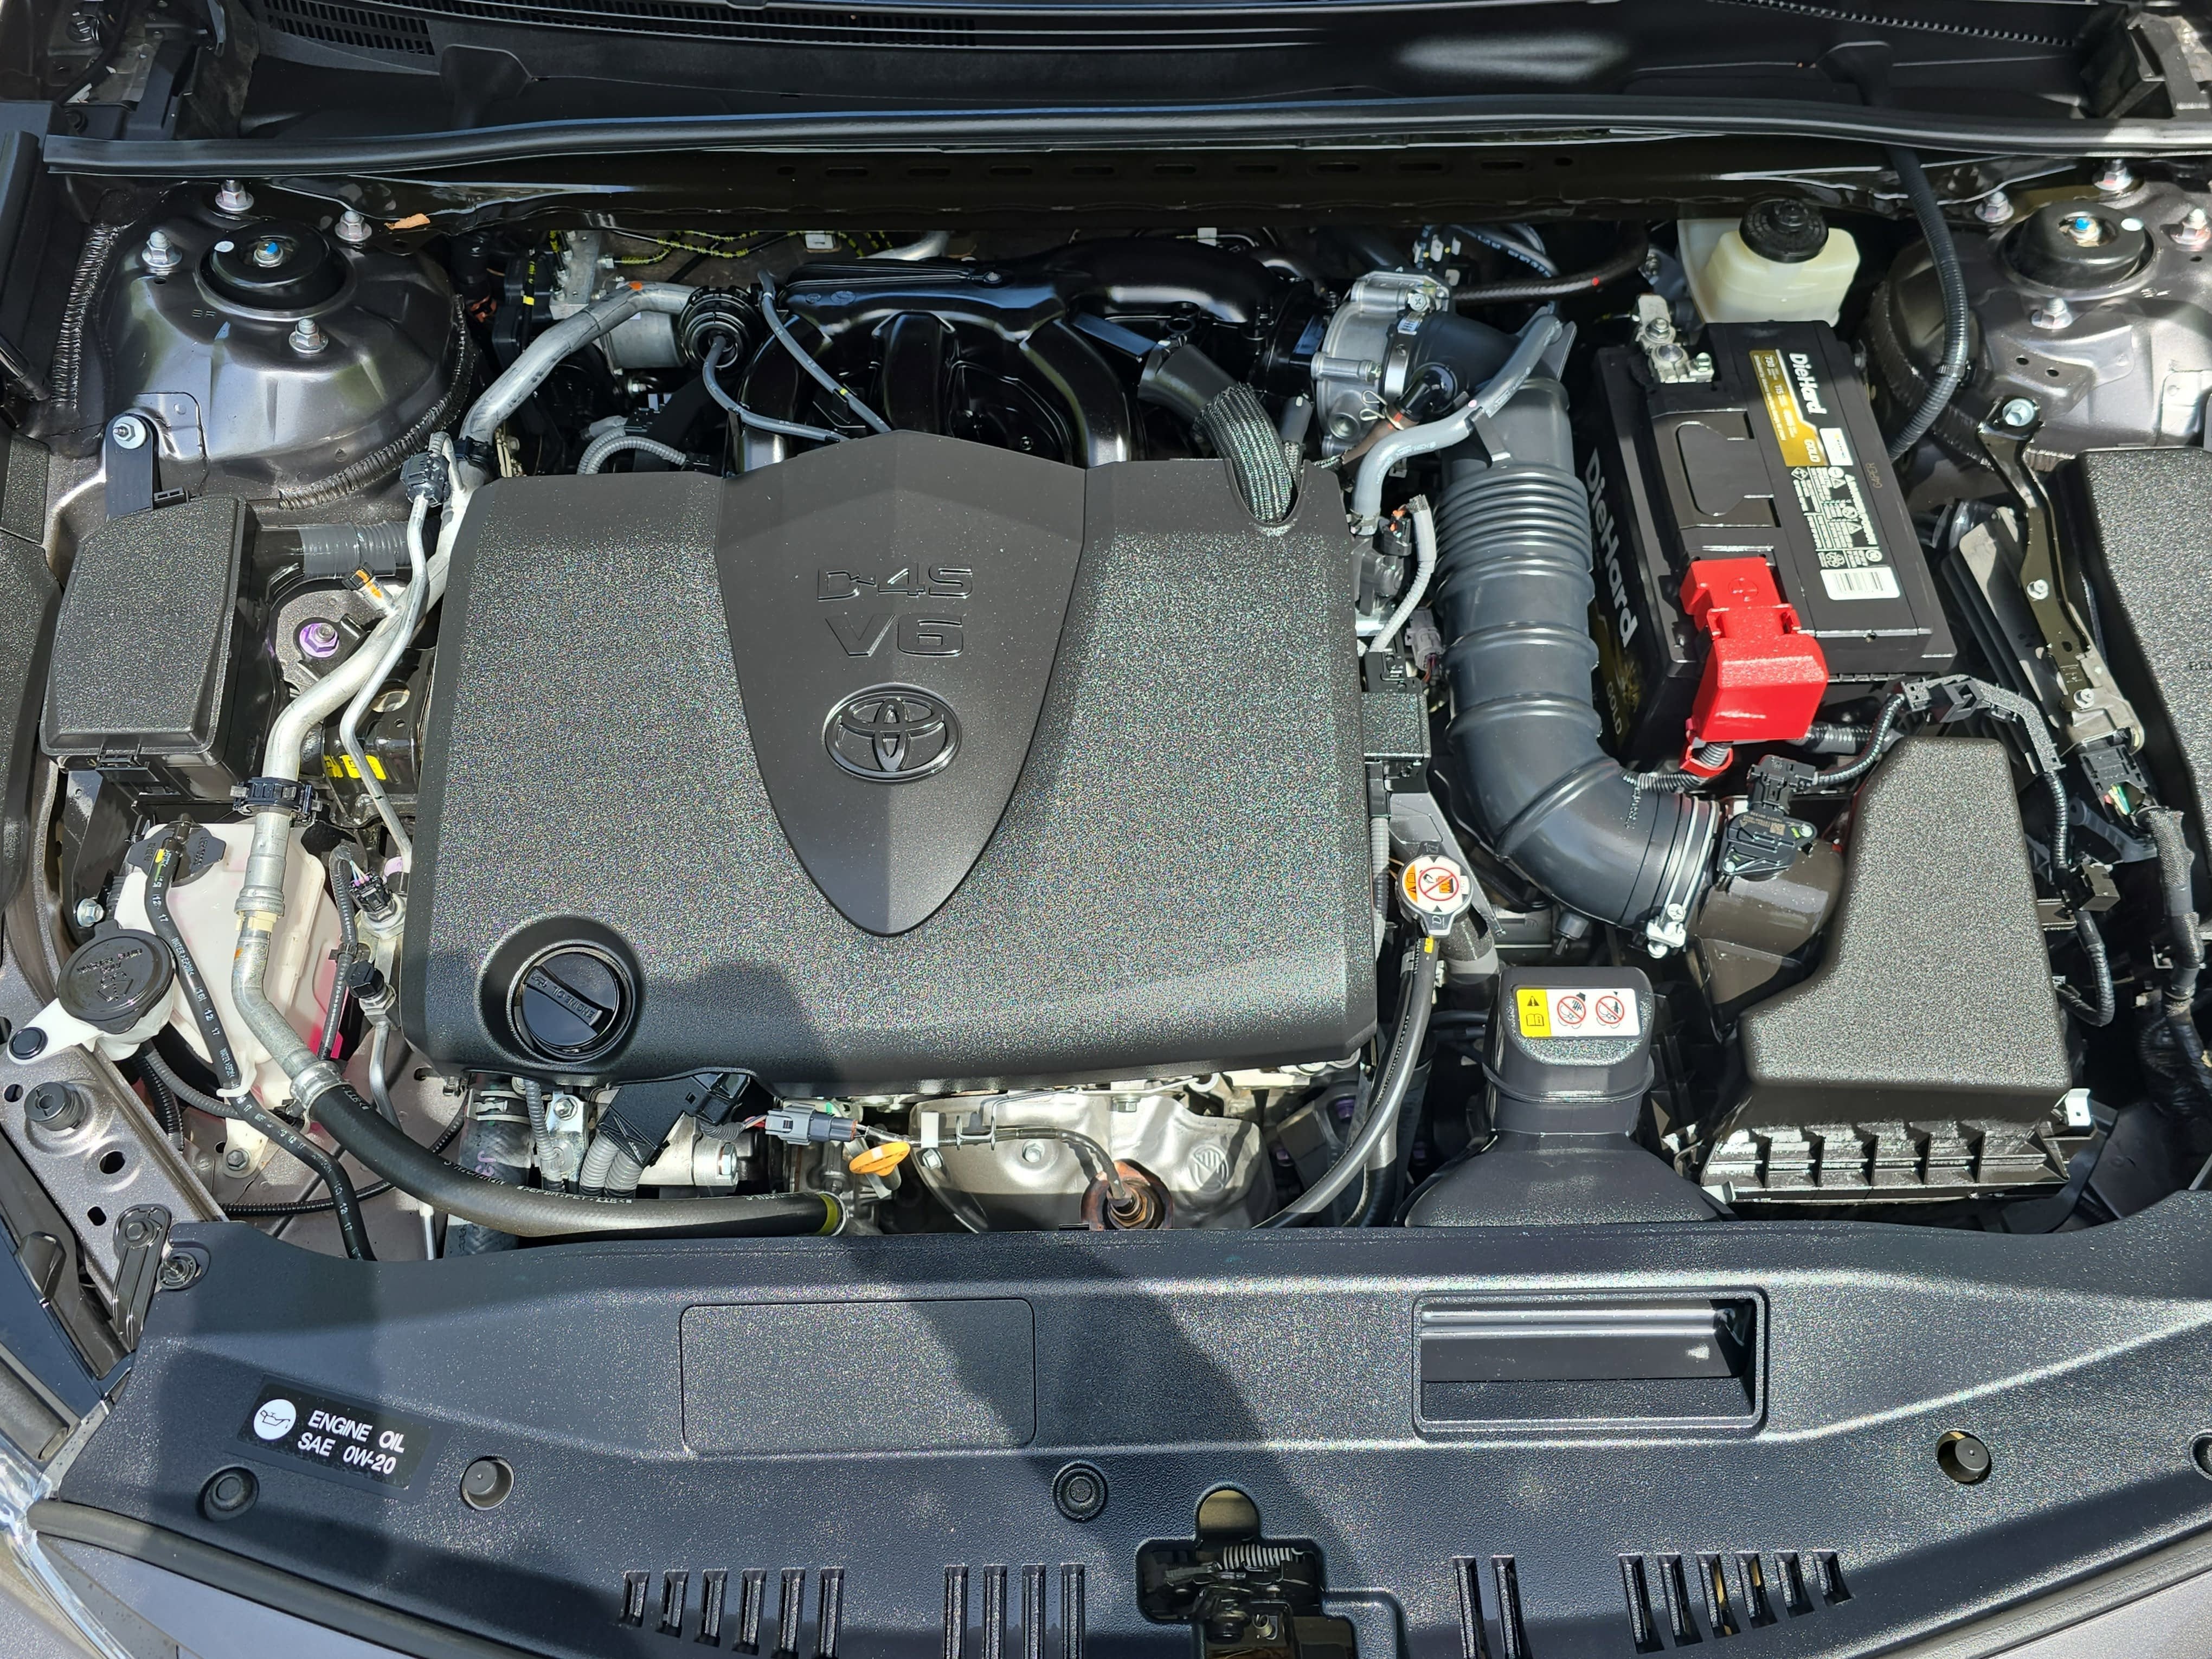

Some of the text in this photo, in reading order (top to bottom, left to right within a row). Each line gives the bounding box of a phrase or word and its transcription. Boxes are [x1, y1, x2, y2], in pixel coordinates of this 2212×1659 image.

[1789, 352, 1827, 414] DieHard
[1804, 439, 1821, 462] GOLD
[1585, 447, 1638, 648] DieHard
[817, 563, 973, 601] D-4S
[825, 613, 963, 657] V6
[1606, 680, 1622, 735] GOLD
[171, 937, 186, 956] WATER
[552, 985, 596, 1019] ENGINE OIL
[211, 1027, 220, 1036] 17
[298, 1432, 397, 1475] SAE 0W-20
[307, 1410, 406, 1454] ENGINE OIL
